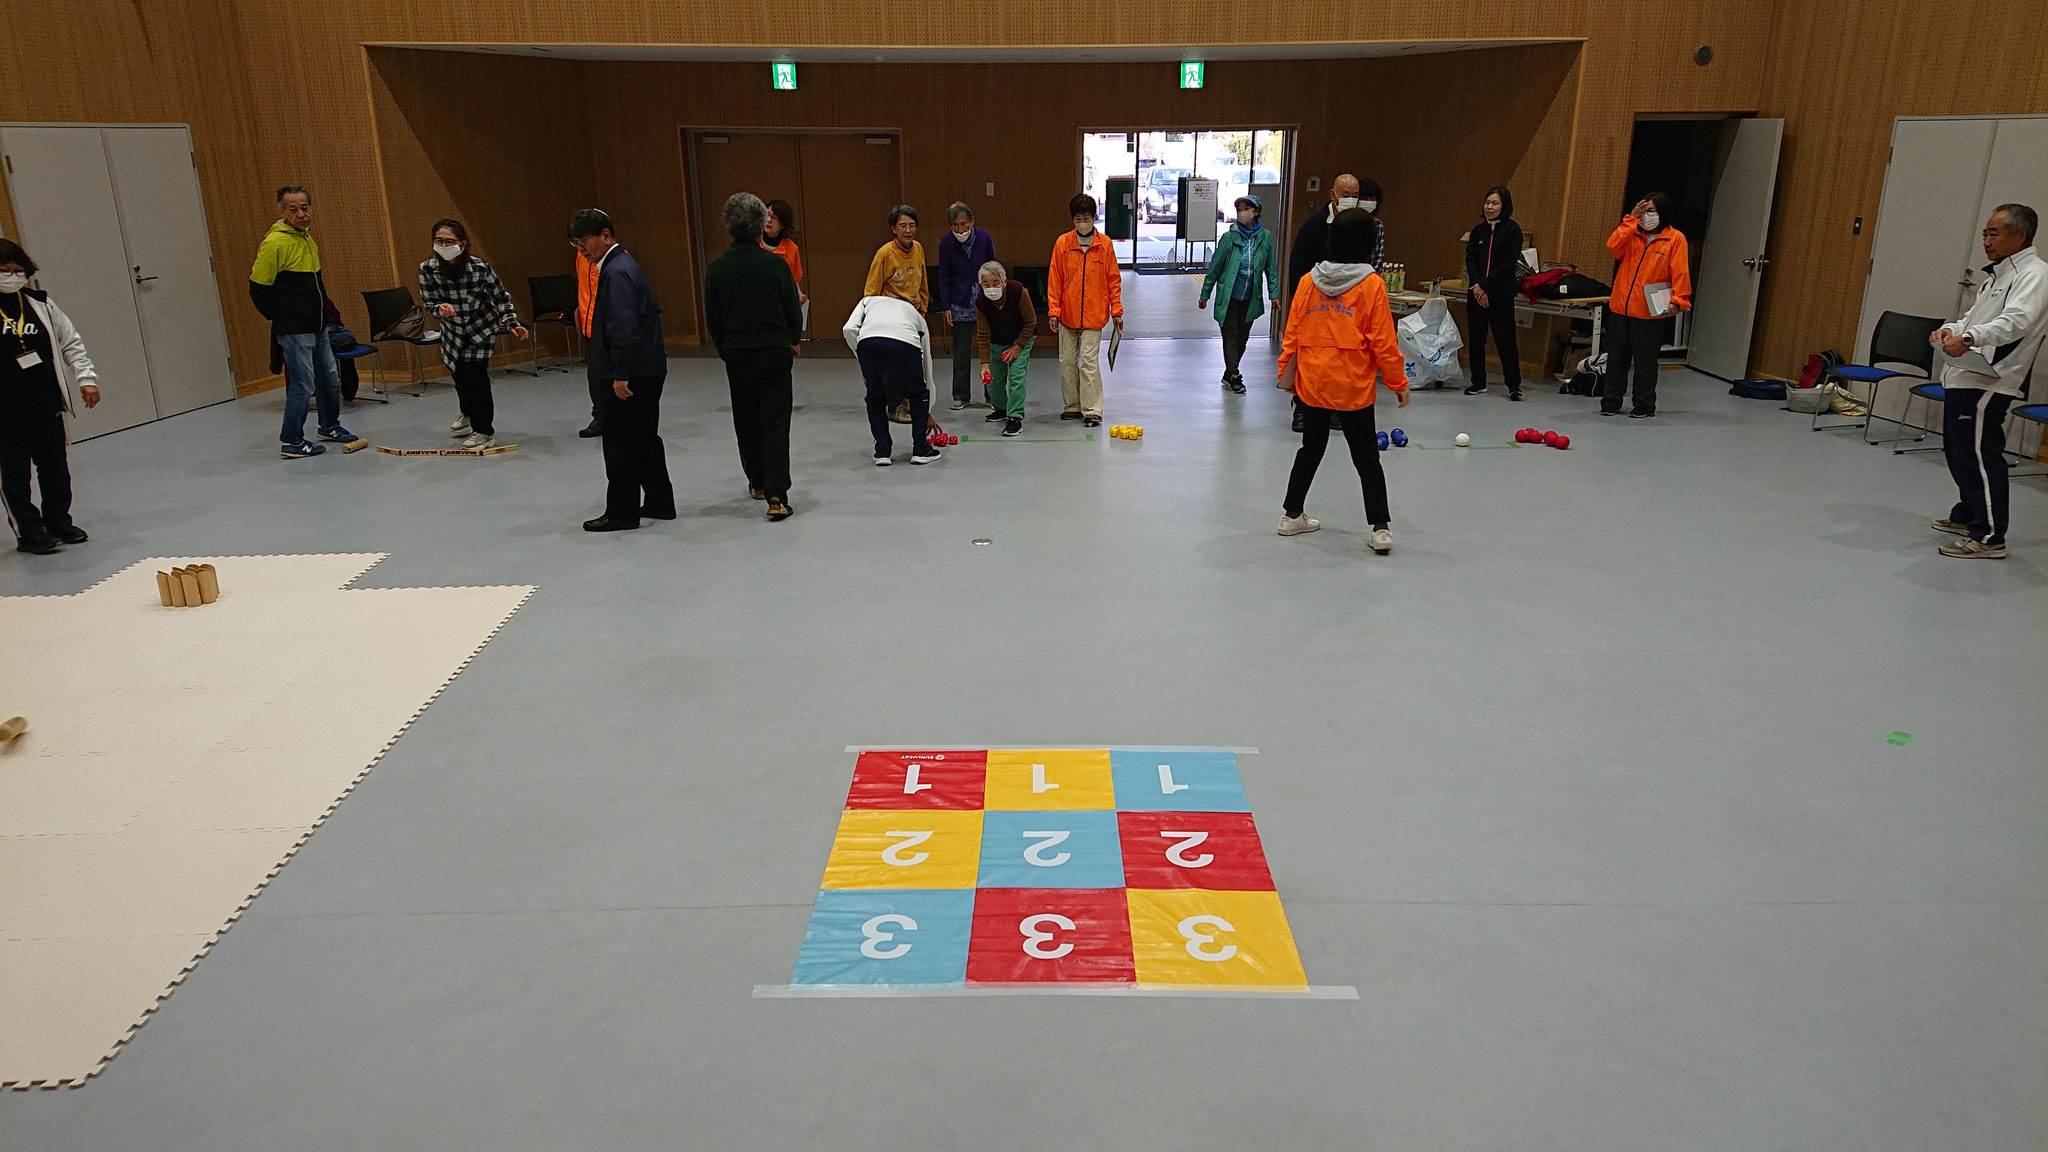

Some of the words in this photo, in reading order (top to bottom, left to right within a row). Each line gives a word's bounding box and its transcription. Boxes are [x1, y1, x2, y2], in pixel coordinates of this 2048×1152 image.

[903, 764, 932, 794] 1
[1032, 763, 1060, 793] 1
[1157, 764, 1190, 795] 1
[881, 830, 933, 867] 2
[1022, 830, 1072, 868] 2
[1160, 831, 1214, 868] 2
[859, 913, 918, 960] 3
[1019, 913, 1077, 959] 3
[1177, 915, 1237, 962] 3
